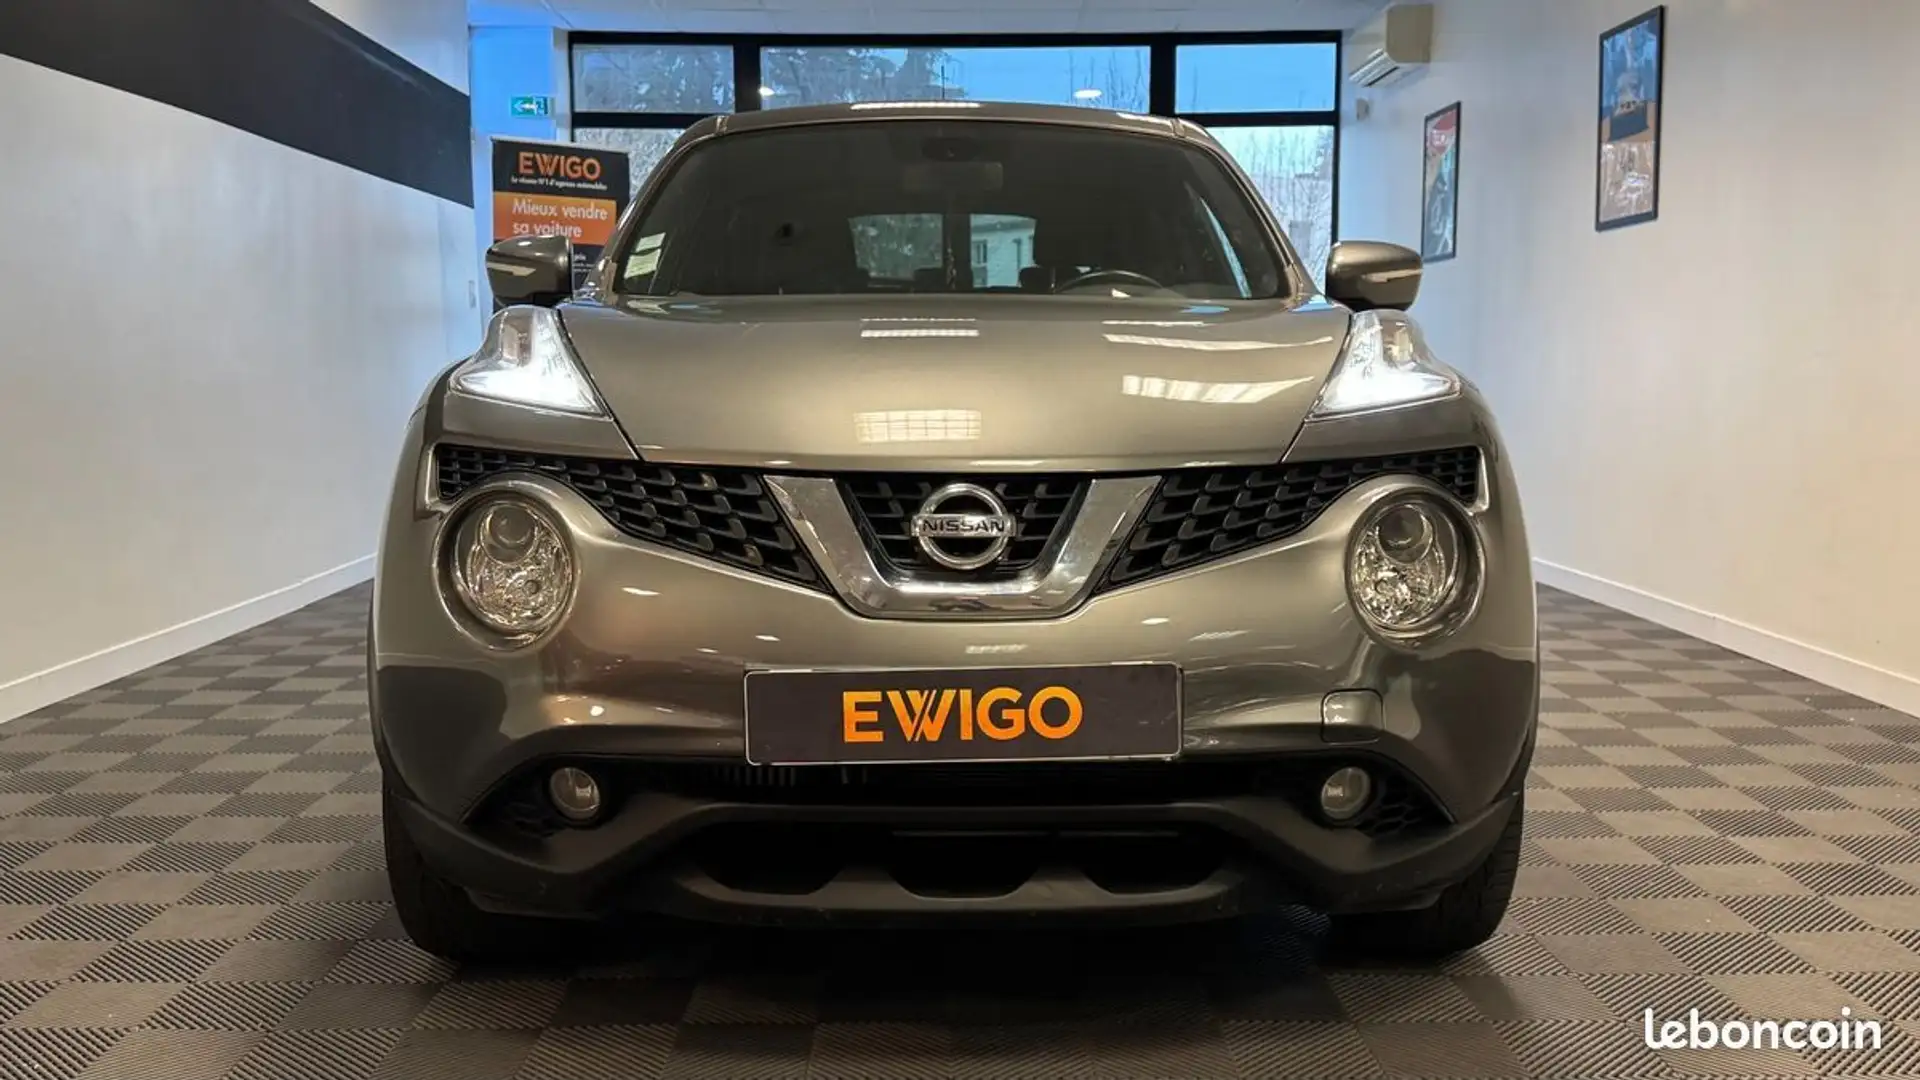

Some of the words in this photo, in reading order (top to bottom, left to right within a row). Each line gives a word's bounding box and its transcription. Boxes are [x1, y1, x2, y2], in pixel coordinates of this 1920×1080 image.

[519, 152, 601, 180] EWIGO
[512, 199, 558, 217] Mieux
[562, 202, 608, 221] vendre
[512, 222, 530, 235] sa
[533, 222, 582, 237] voiture
[921, 517, 1006, 533] NISSAN
[842, 686, 1083, 742] EWIGO
